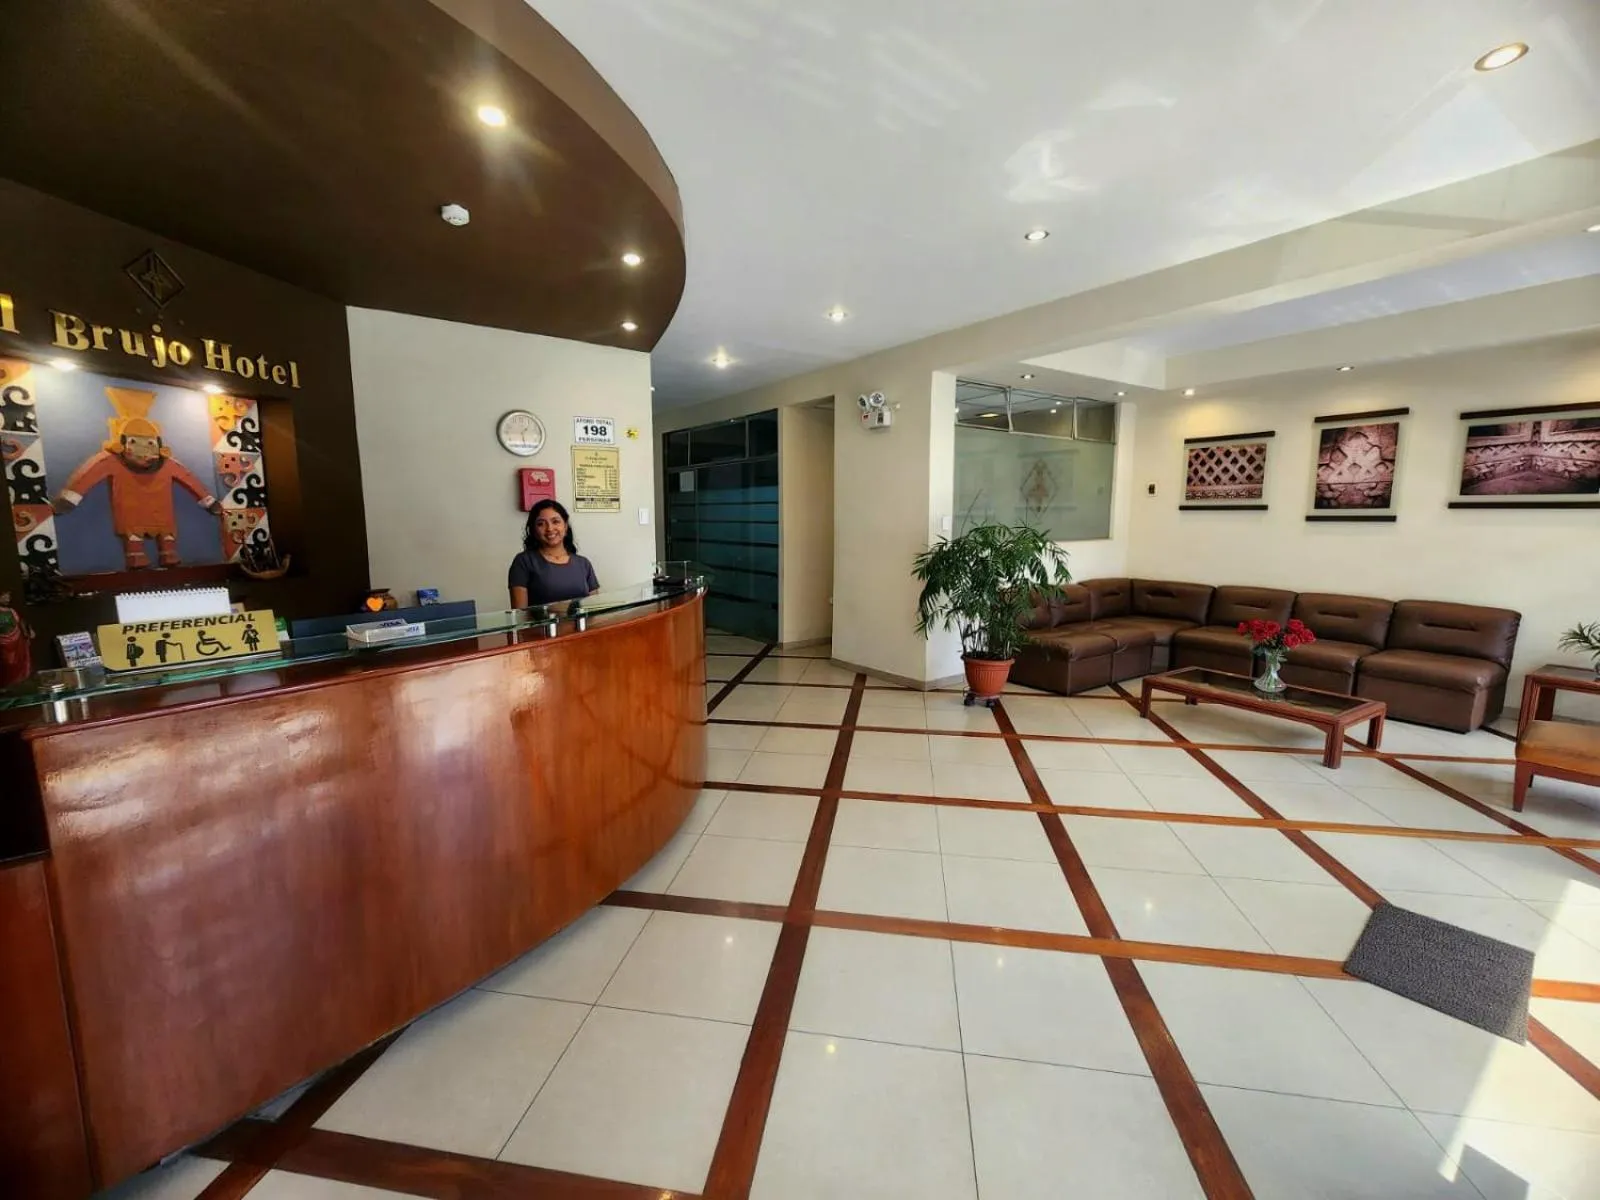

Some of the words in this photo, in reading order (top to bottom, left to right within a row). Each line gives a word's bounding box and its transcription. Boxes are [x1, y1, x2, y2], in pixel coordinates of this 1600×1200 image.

[50, 309, 193, 368] Brujo
[201, 337, 301, 388] Hotel
[583, 425, 607, 436] 198
[122, 613, 256, 635] PREFERENCIAL
